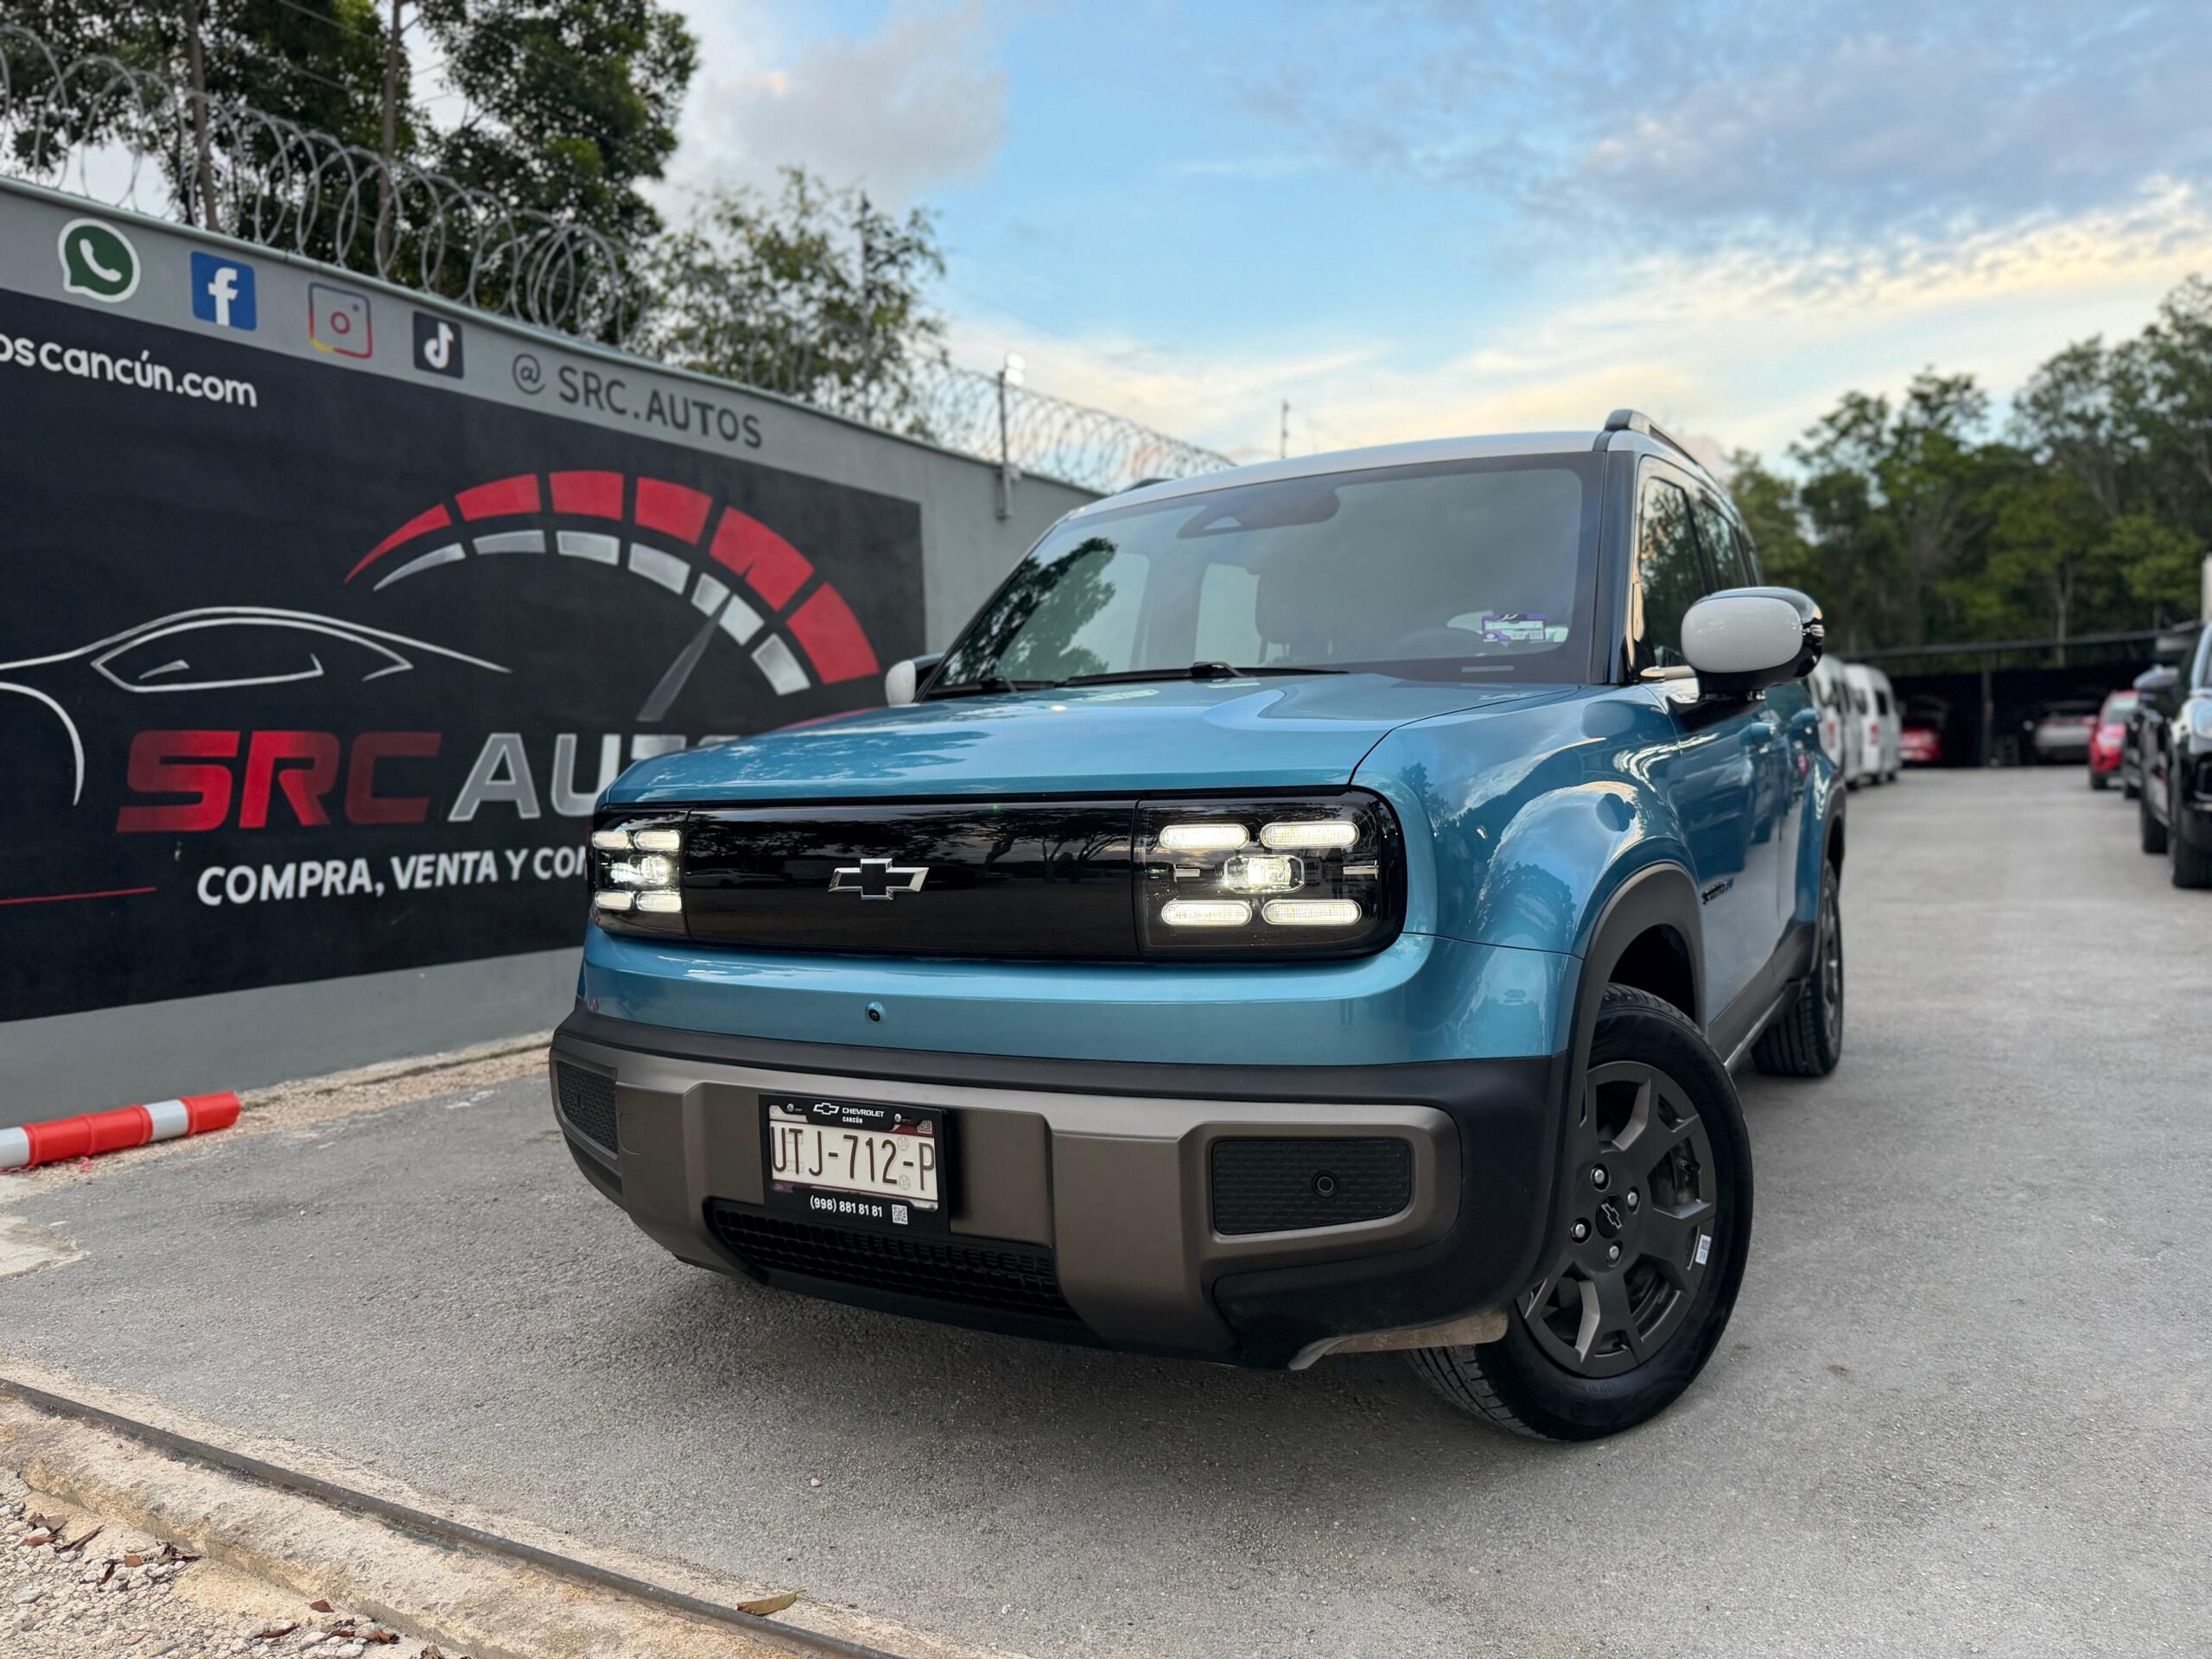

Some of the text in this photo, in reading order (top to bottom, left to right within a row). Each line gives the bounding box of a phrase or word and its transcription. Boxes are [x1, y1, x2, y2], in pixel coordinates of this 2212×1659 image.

[558, 365, 762, 449] SRC.AUTOS
[117, 730, 442, 833] SRC
[197, 858, 385, 906] COMPRA,
[391, 849, 499, 891] VENTA
[505, 848, 530, 881] Y
[842, 1107, 885, 1118] CHEVROLET
[842, 1116, 863, 1124] CANCÚN
[771, 1126, 935, 1191] UTJ-712-P
[810, 1195, 882, 1217] (998) 881 81 81
